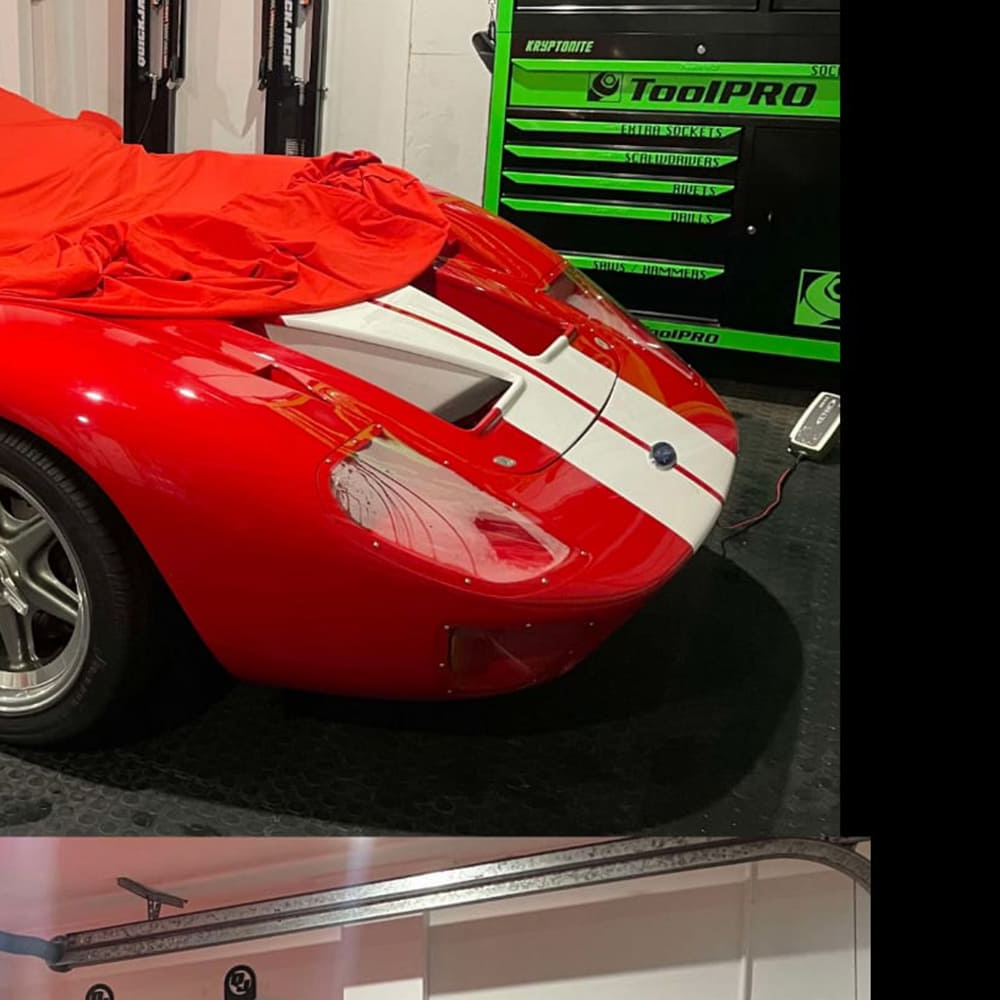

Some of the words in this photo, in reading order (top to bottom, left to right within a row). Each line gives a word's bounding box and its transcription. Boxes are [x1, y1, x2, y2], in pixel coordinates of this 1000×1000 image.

[525, 39, 594, 53] KRYPTONITE
[811, 65, 840, 77] SOC
[631, 78, 817, 107] ToolPRO
[621, 123, 661, 136] EXTRA
[666, 125, 723, 138] SOCKETS
[625, 152, 720, 167] SCREWDRIVERS
[673, 183, 716, 196] RIVETS
[671, 211, 713, 224] DRILLS
[593, 260, 625, 273] SAWS
[642, 264, 707, 280] HAMMERS
[651, 328, 720, 344] olPRO
